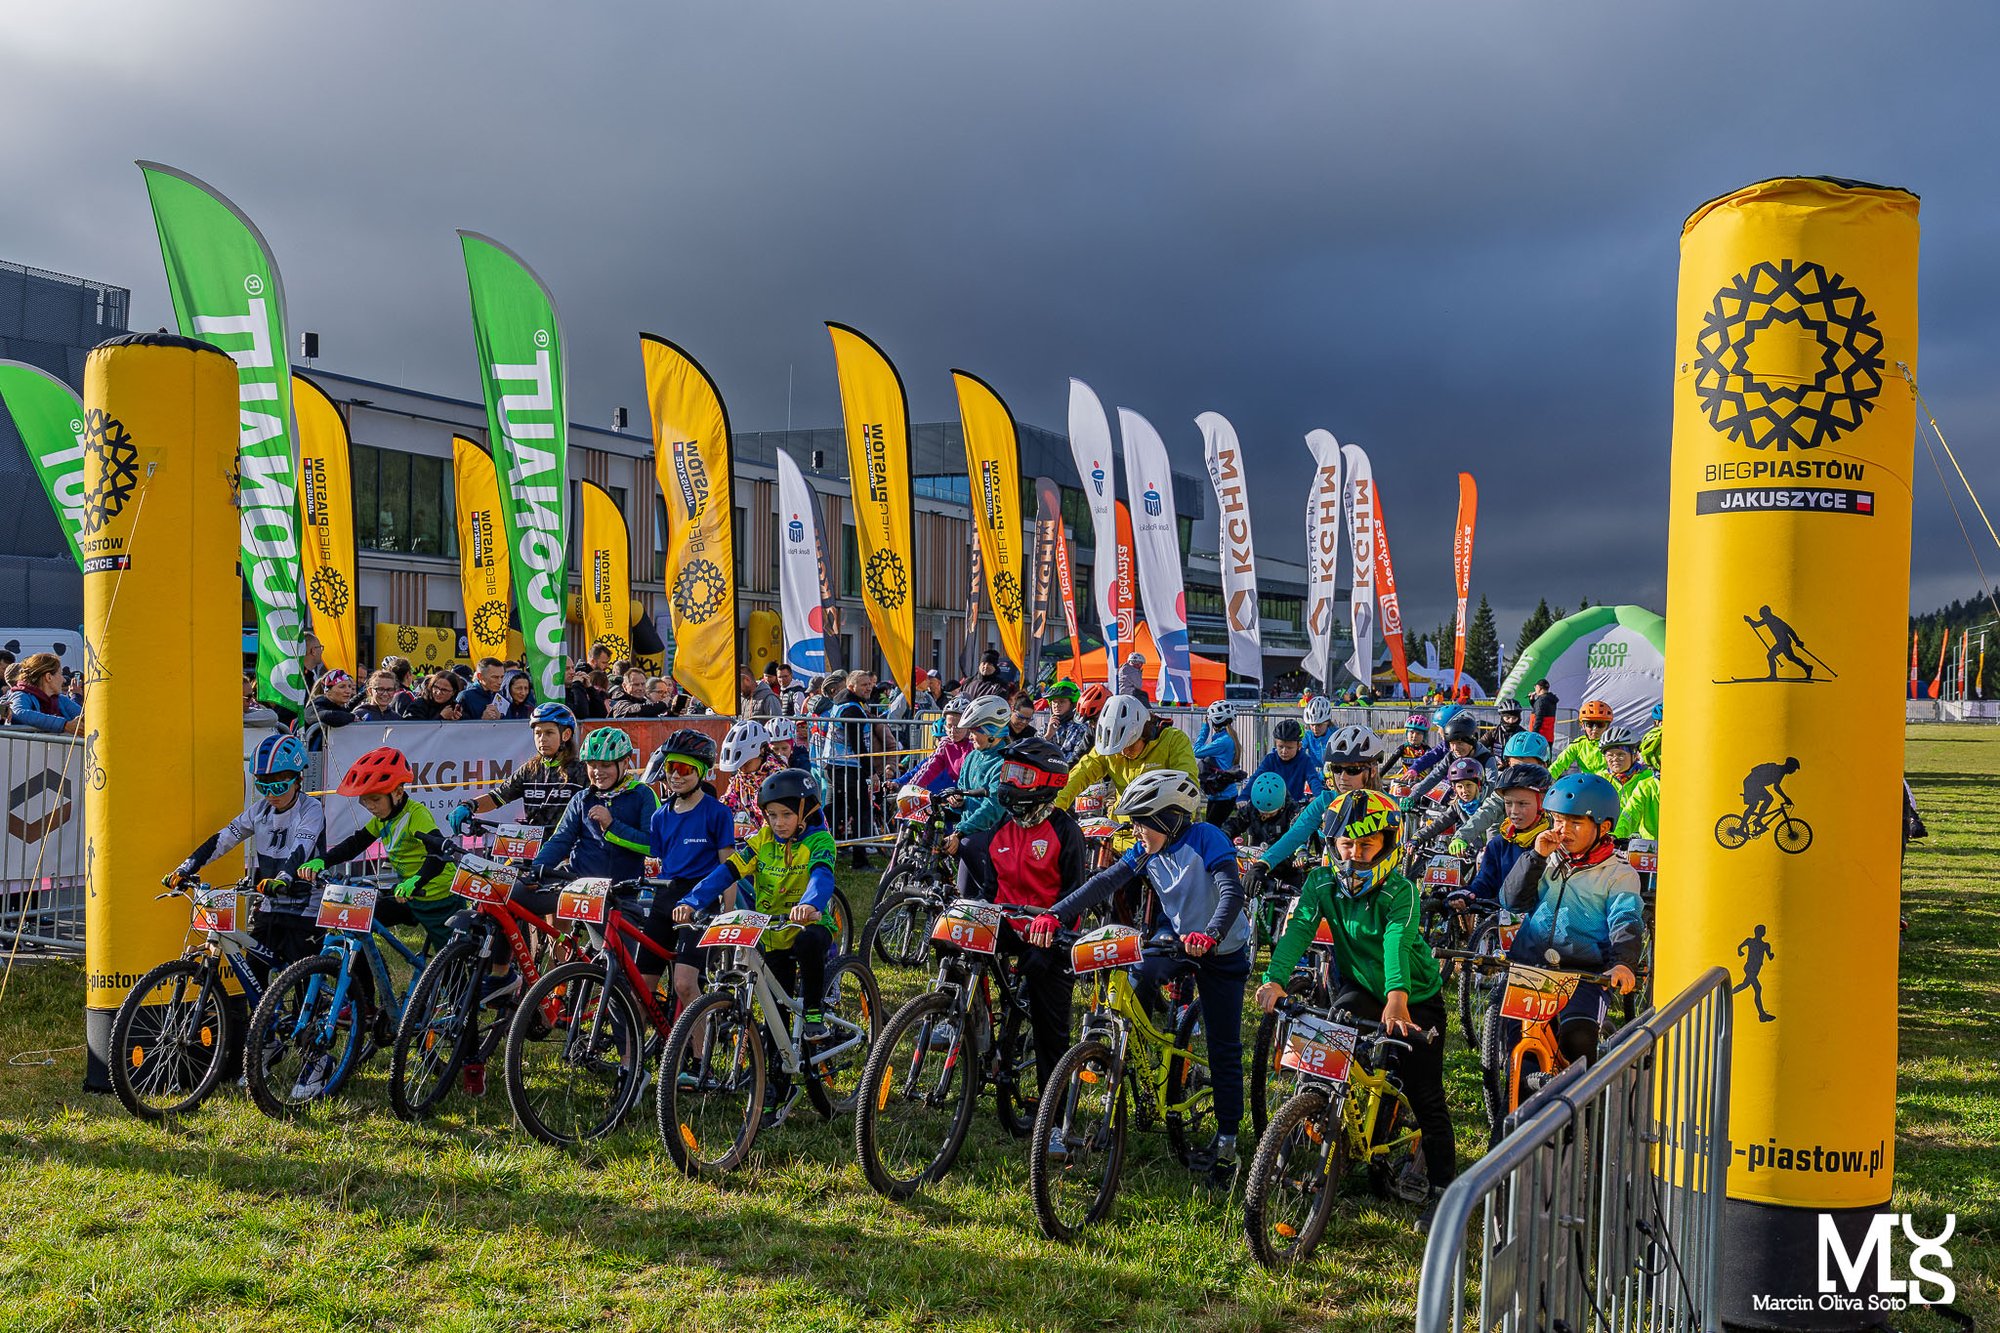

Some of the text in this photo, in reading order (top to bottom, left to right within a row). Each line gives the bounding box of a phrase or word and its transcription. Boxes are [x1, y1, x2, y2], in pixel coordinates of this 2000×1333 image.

[1705, 458, 1864, 482] BIEGPIASTÓW
[1720, 491, 1847, 510] JAKUSZYCE
[1589, 642, 1628, 656] COCO
[1588, 655, 1627, 668] NAUT
[411, 759, 513, 793] KGHM
[507, 842, 526, 854] 55
[1640, 856, 1657, 868] 51
[1432, 870, 1447, 880] 86
[469, 879, 492, 896] 54
[573, 899, 589, 914] 76
[338, 909, 349, 923] 4
[718, 928, 742, 940] 99
[951, 924, 975, 942] 81
[1093, 943, 1119, 962] 52
[1522, 996, 1558, 1015] 110
[1728, 1138, 1885, 1179] -piastow.pl
